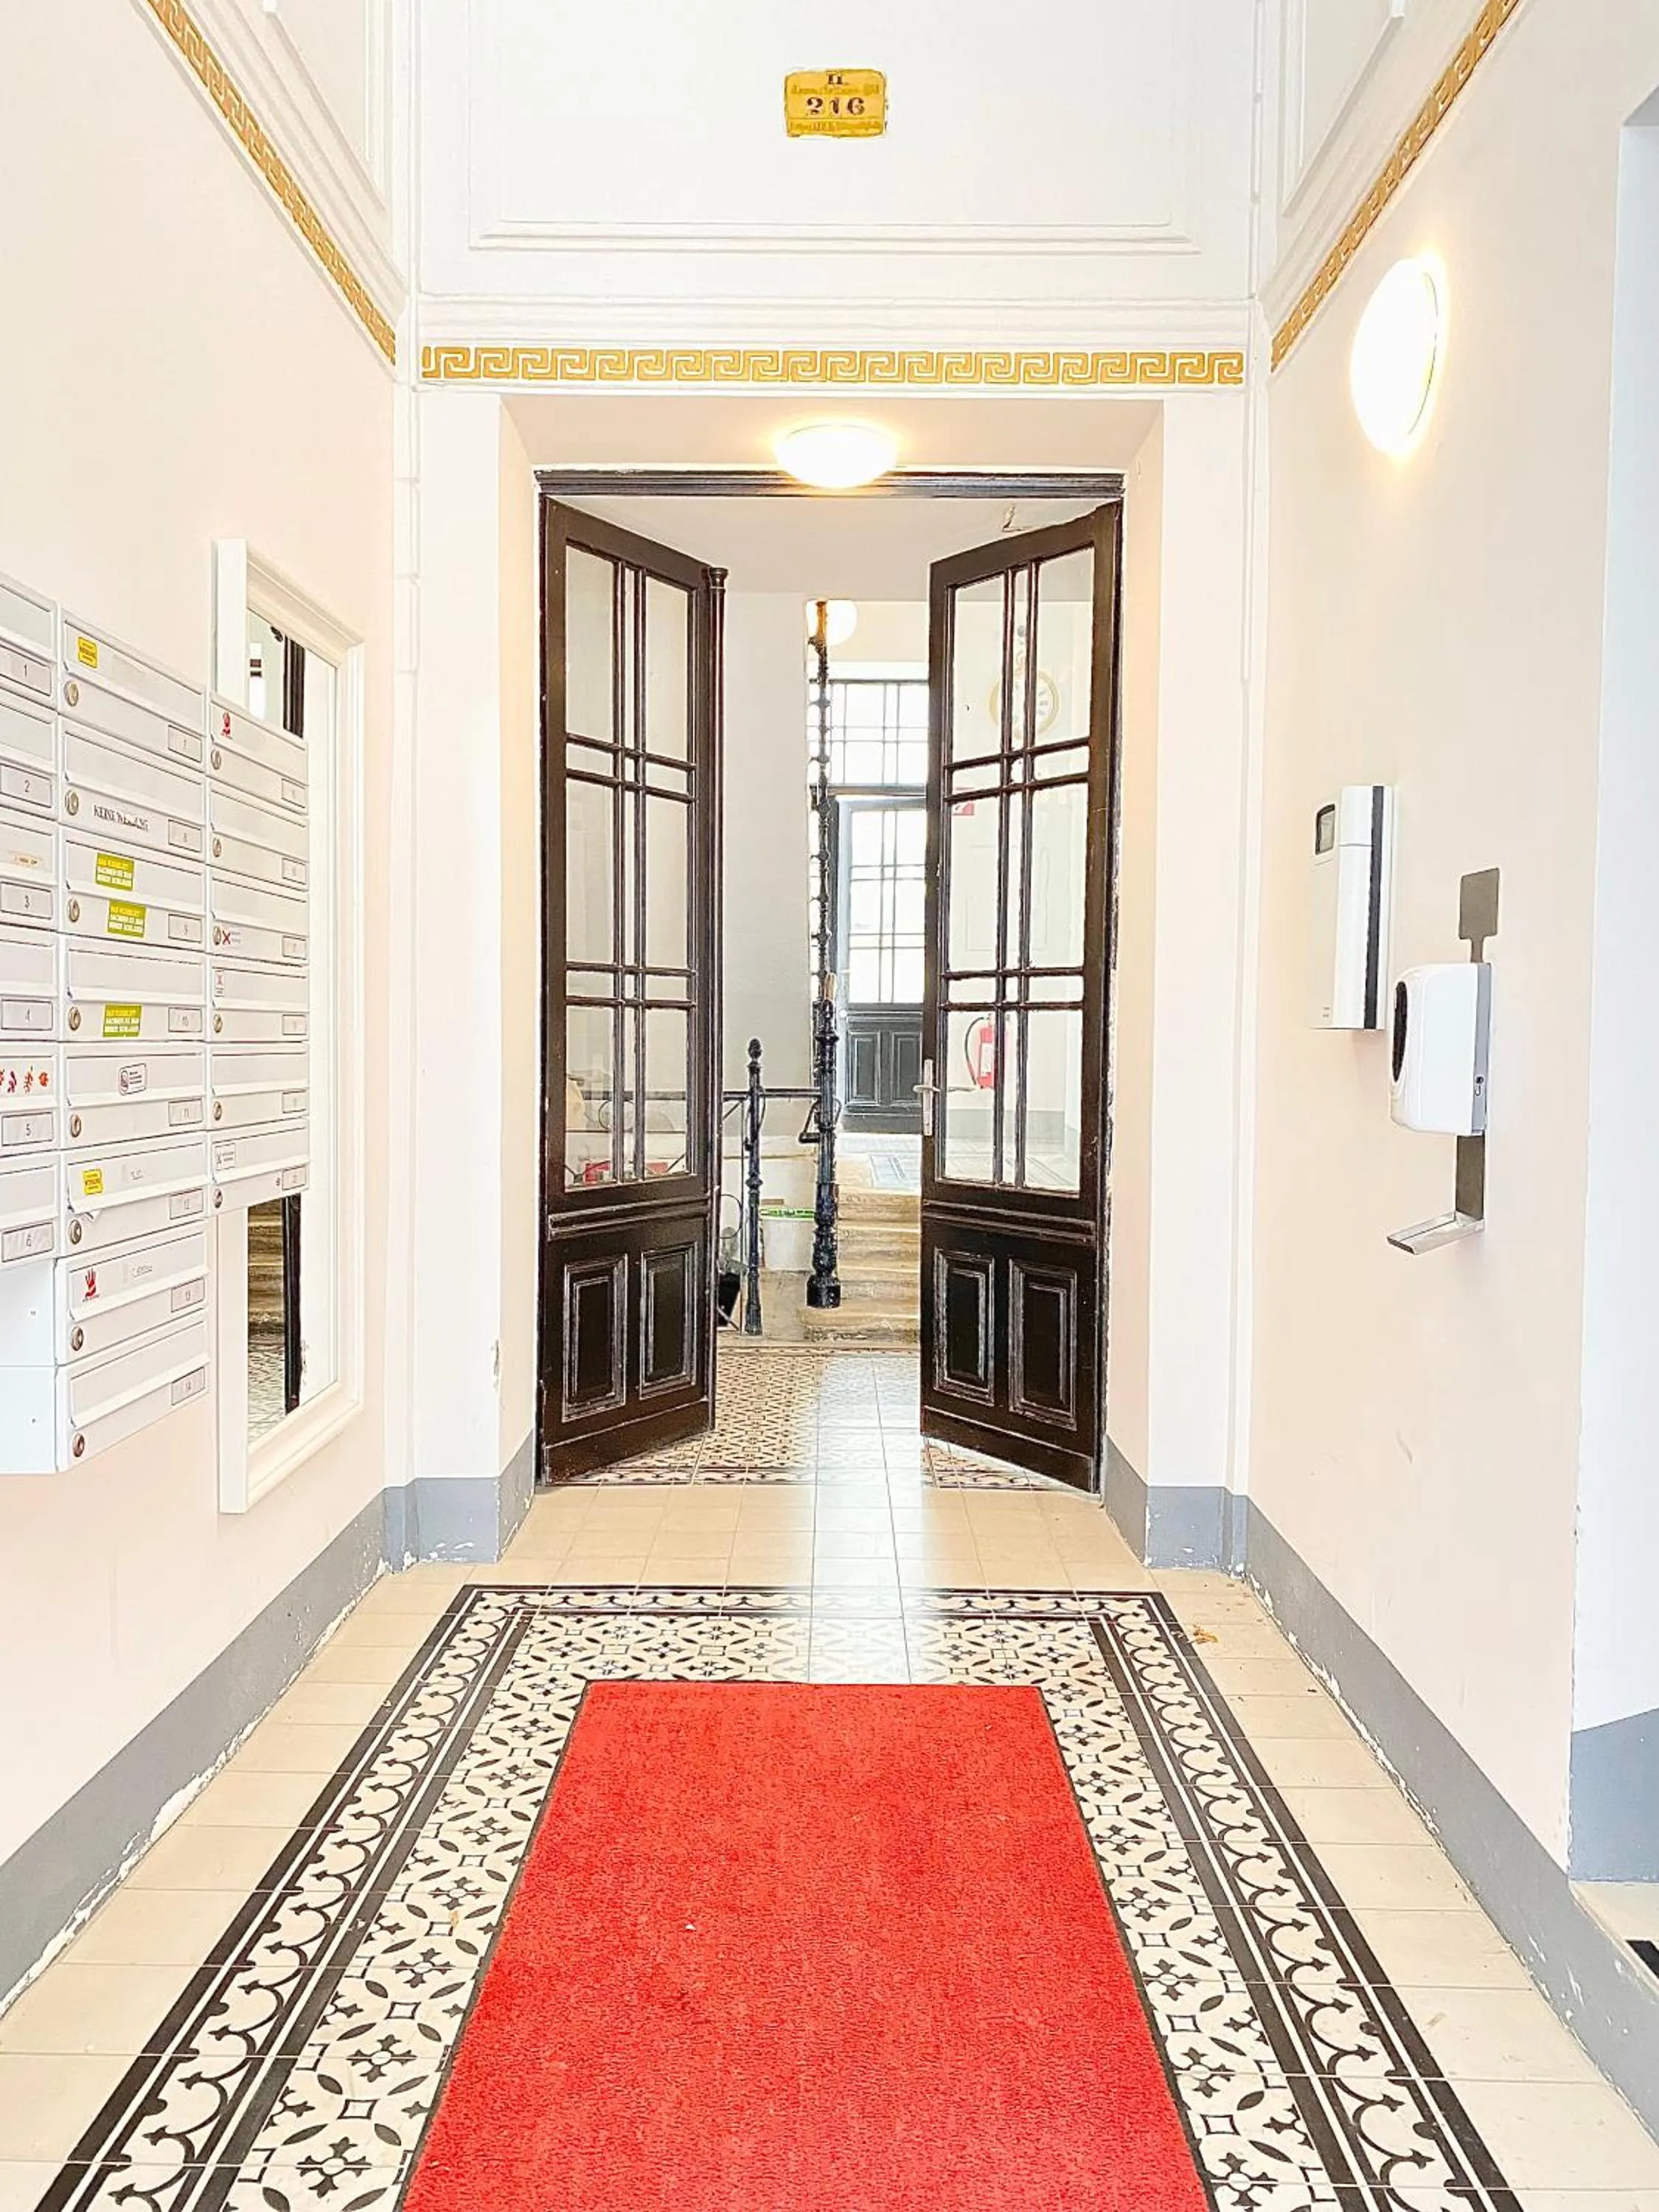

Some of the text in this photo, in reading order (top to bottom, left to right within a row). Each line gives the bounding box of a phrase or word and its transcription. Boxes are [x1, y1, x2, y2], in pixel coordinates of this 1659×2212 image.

[805, 97, 865, 116] 216
[24, 779, 30, 793] 2
[24, 895, 30, 908] 3
[26, 1123, 32, 1137] 5
[26, 1232, 32, 1247] 6
